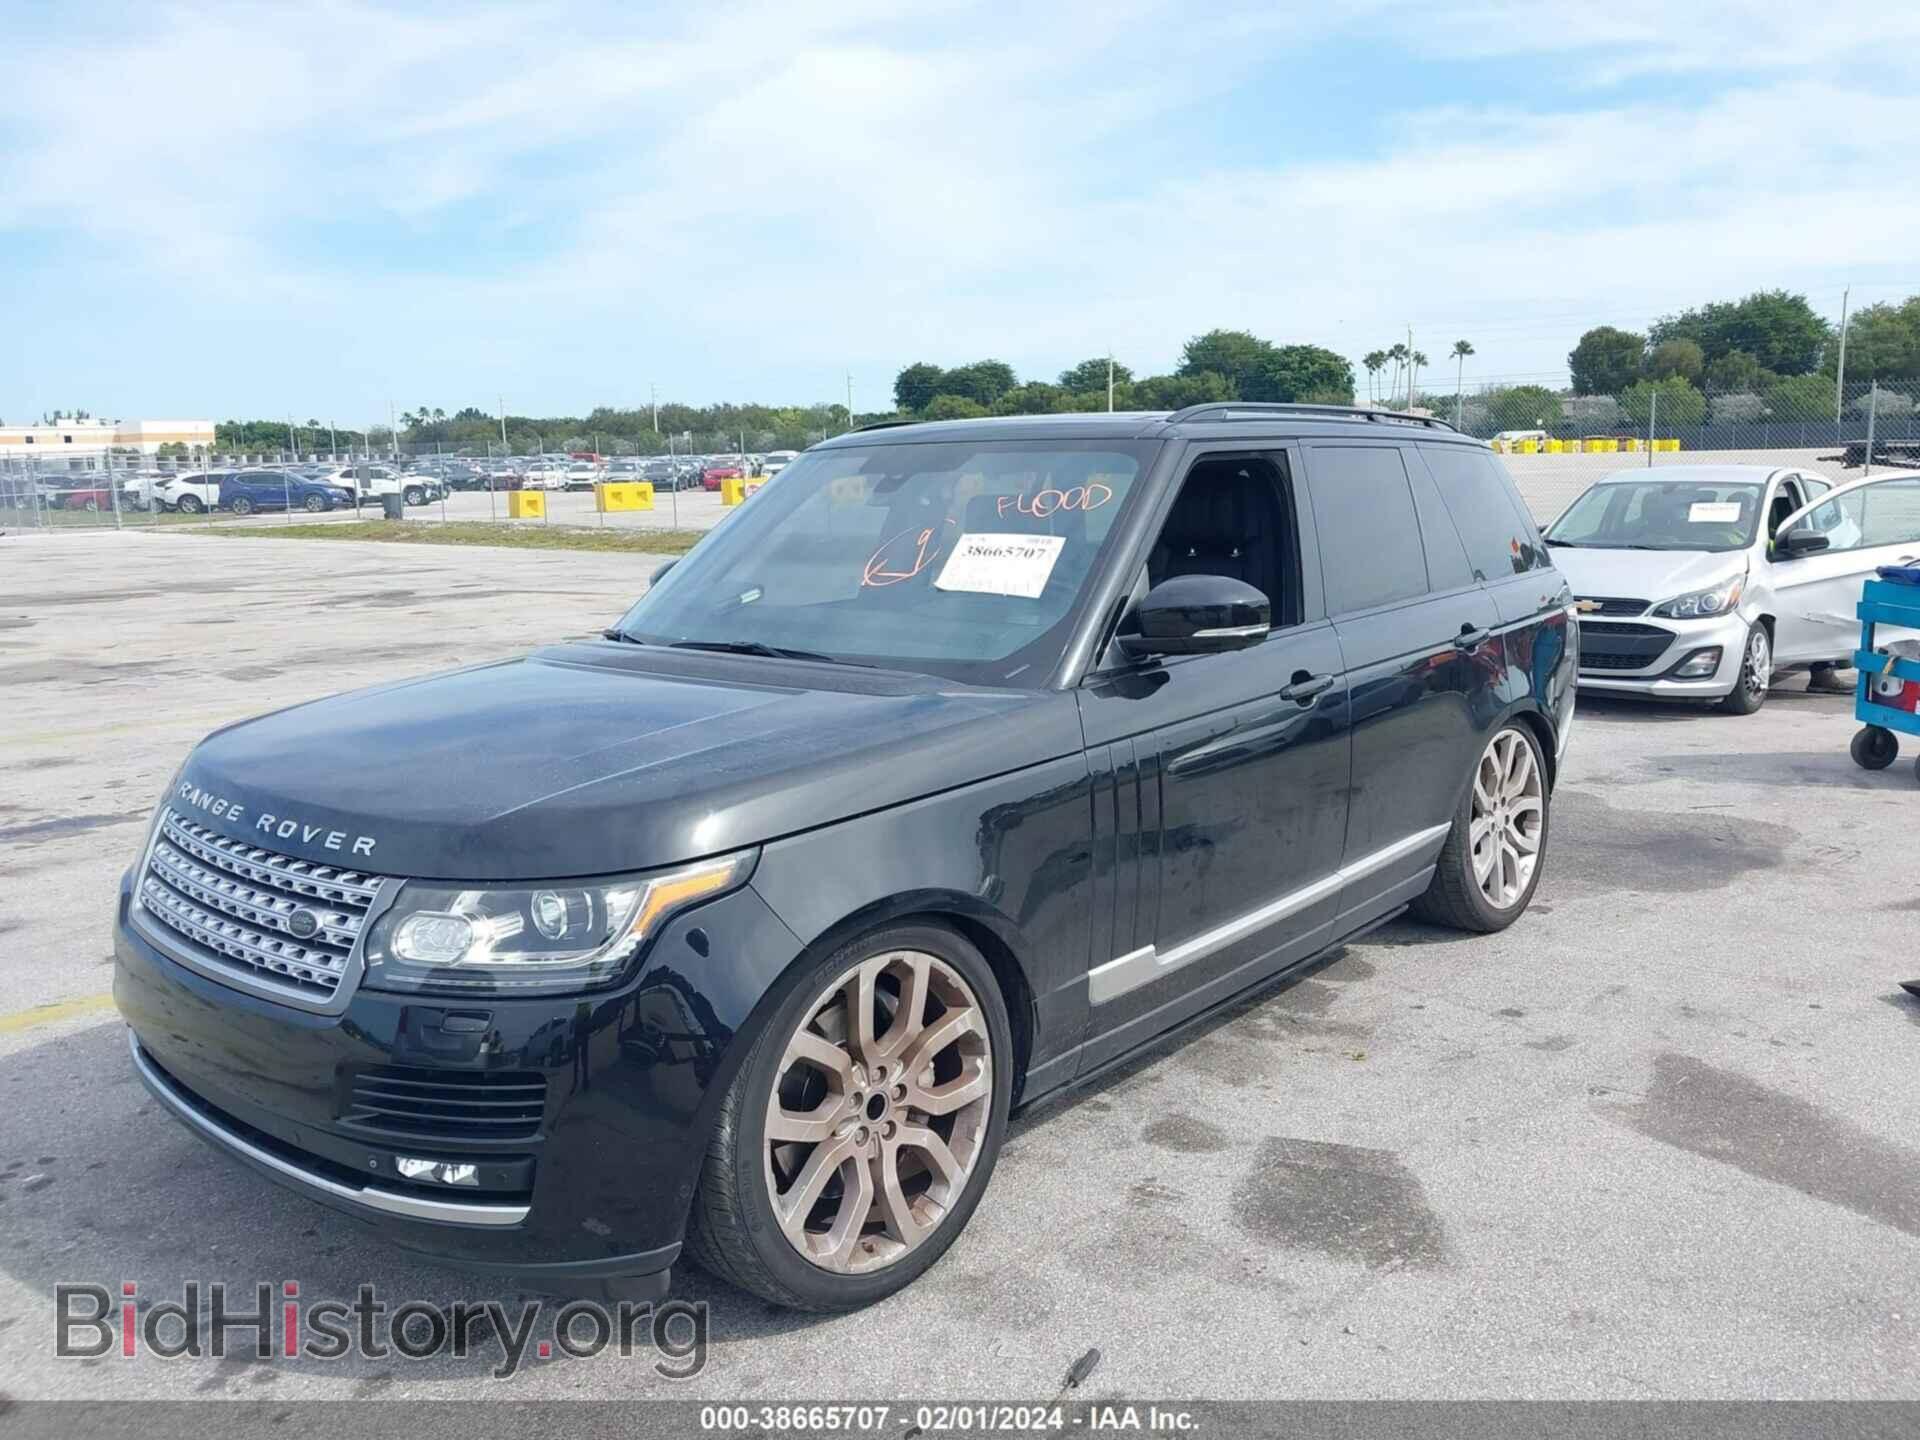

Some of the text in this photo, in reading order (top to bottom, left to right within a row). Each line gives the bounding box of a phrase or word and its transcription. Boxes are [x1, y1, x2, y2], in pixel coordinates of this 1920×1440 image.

[997, 483, 1113, 519] FLOOD
[962, 544, 1047, 560] 38665707
[178, 781, 376, 856] RANGE ROVER
